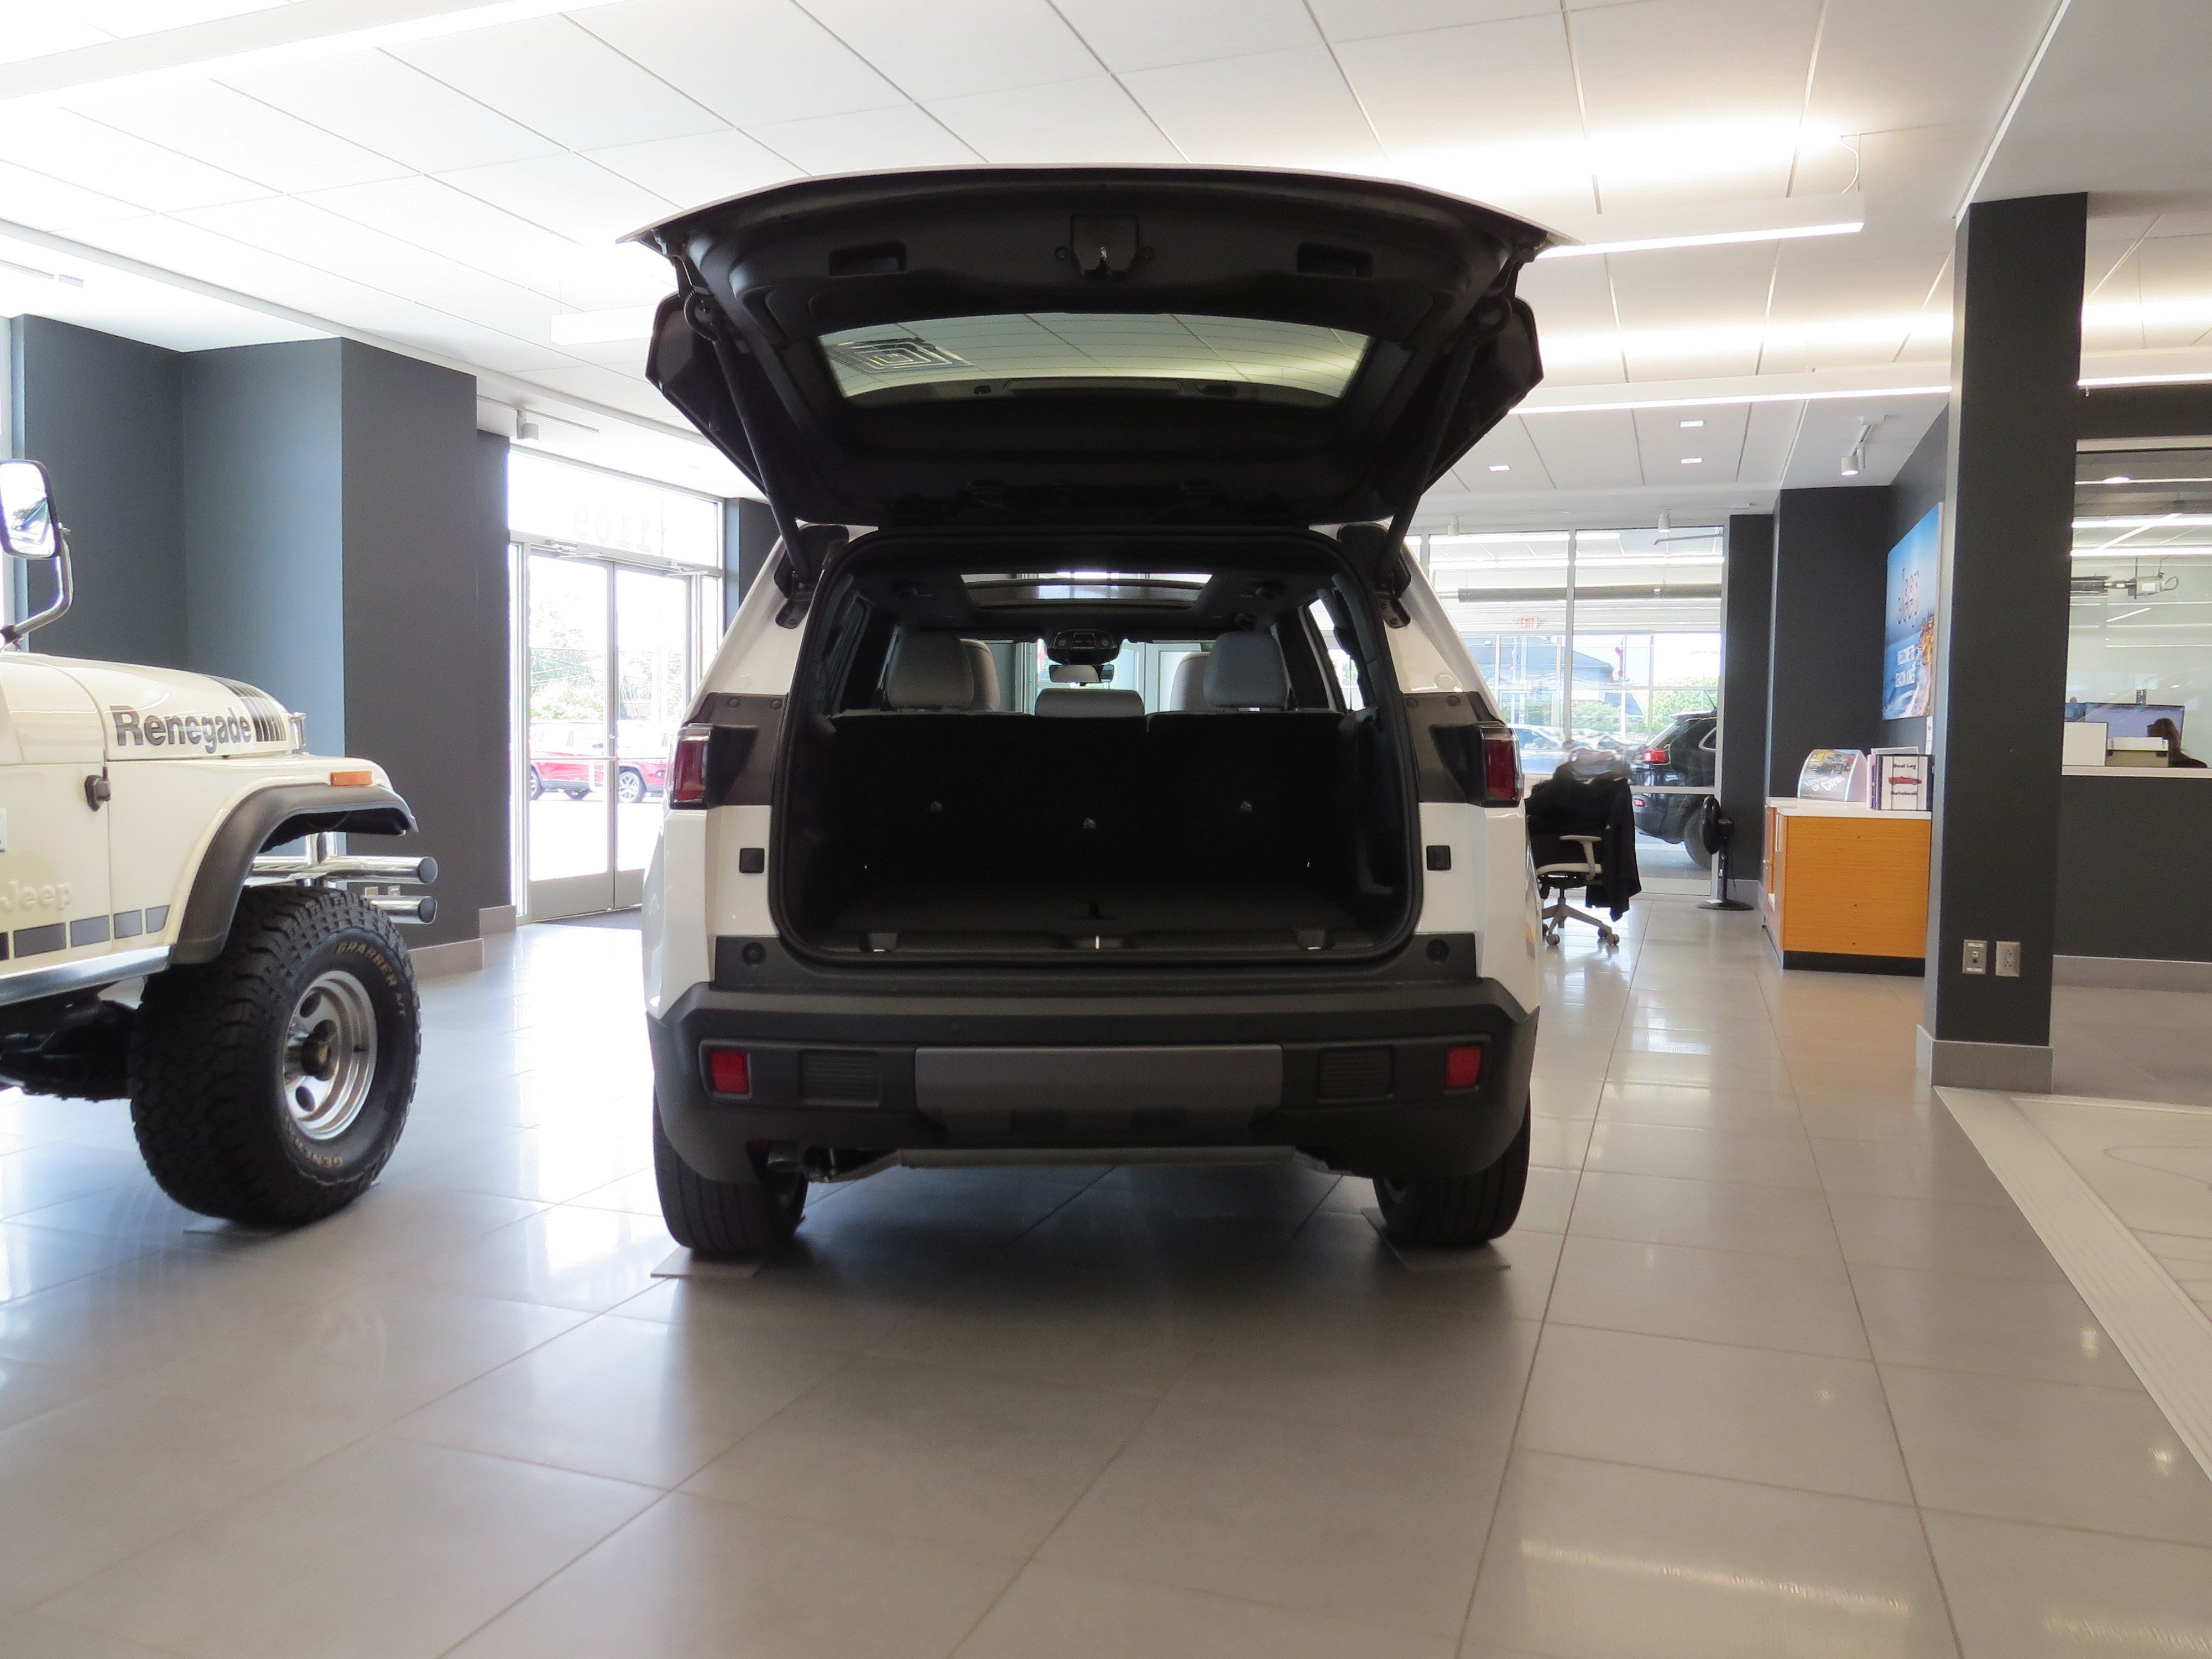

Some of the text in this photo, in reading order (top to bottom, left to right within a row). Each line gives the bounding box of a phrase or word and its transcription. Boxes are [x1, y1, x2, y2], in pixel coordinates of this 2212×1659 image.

[1521, 618, 1535, 628] EXIT
[109, 705, 252, 754] Renegade
[1, 879, 72, 911] Jeep
[337, 941, 398, 987] GRABBER
